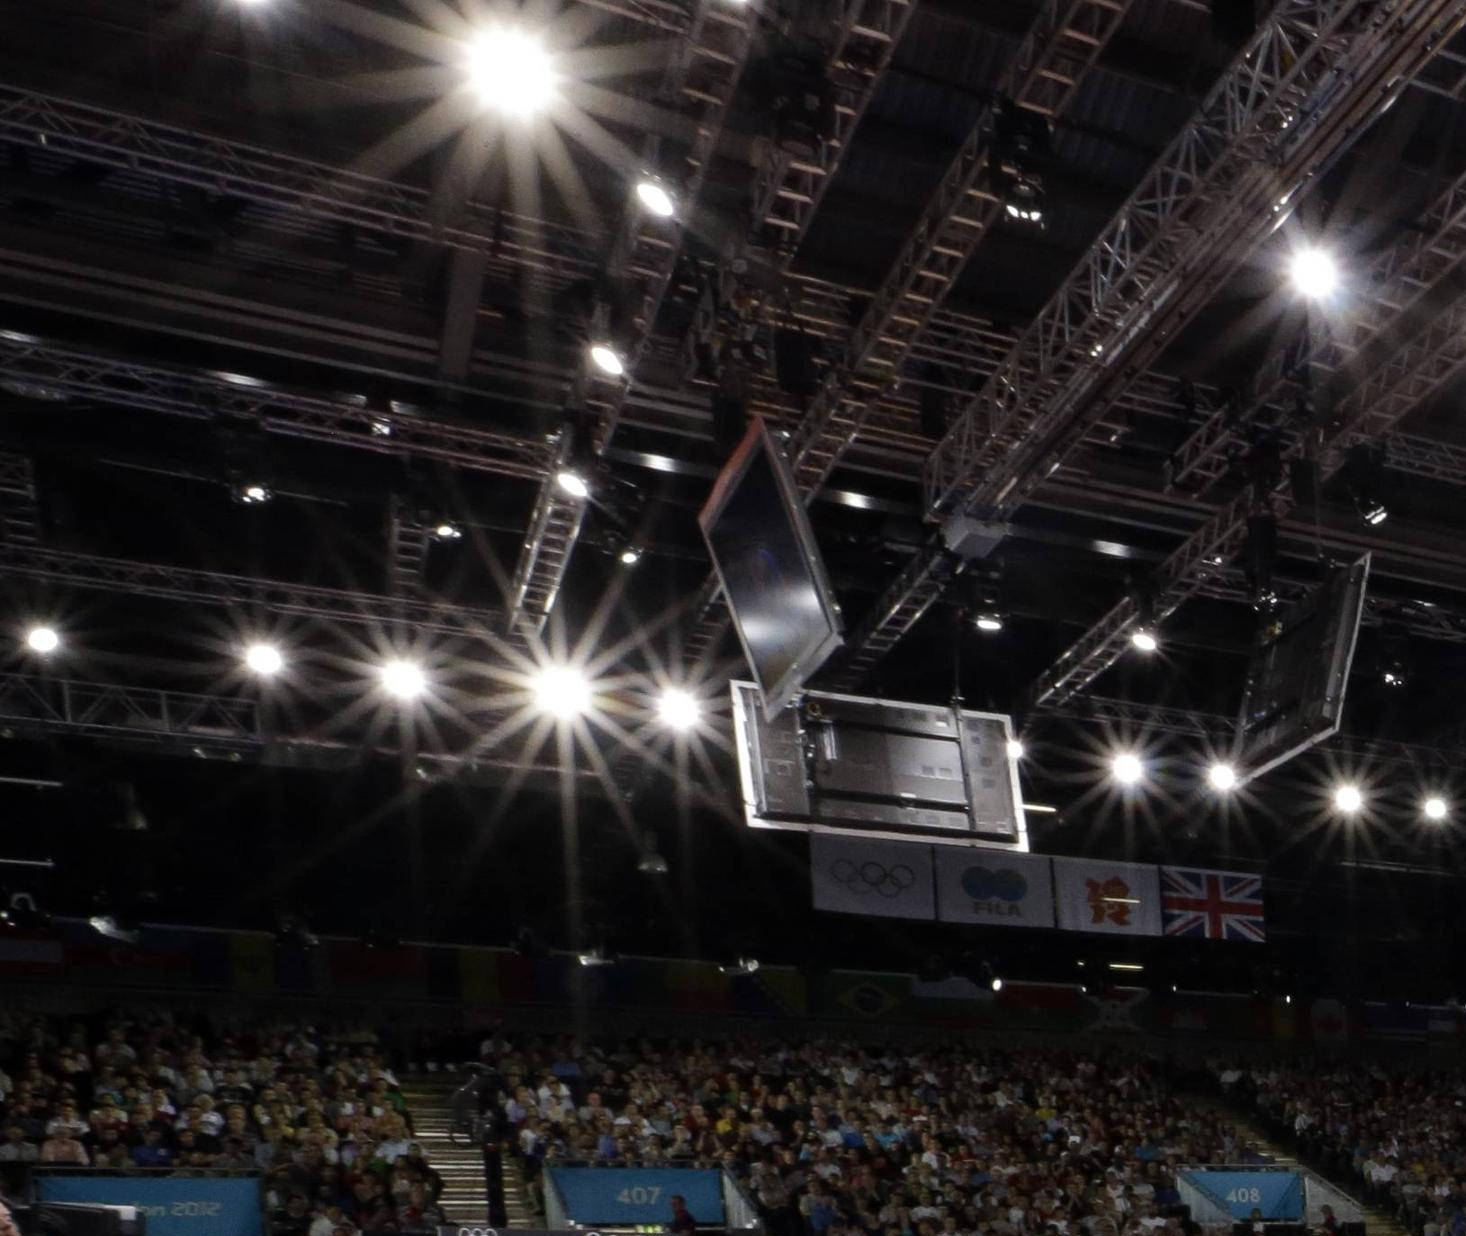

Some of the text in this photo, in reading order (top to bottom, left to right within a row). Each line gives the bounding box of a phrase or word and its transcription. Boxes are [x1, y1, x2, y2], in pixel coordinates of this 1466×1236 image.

[973, 901, 1021, 917] FILA
[616, 1186, 661, 1205] 407
[1226, 1188, 1260, 1203] 408
